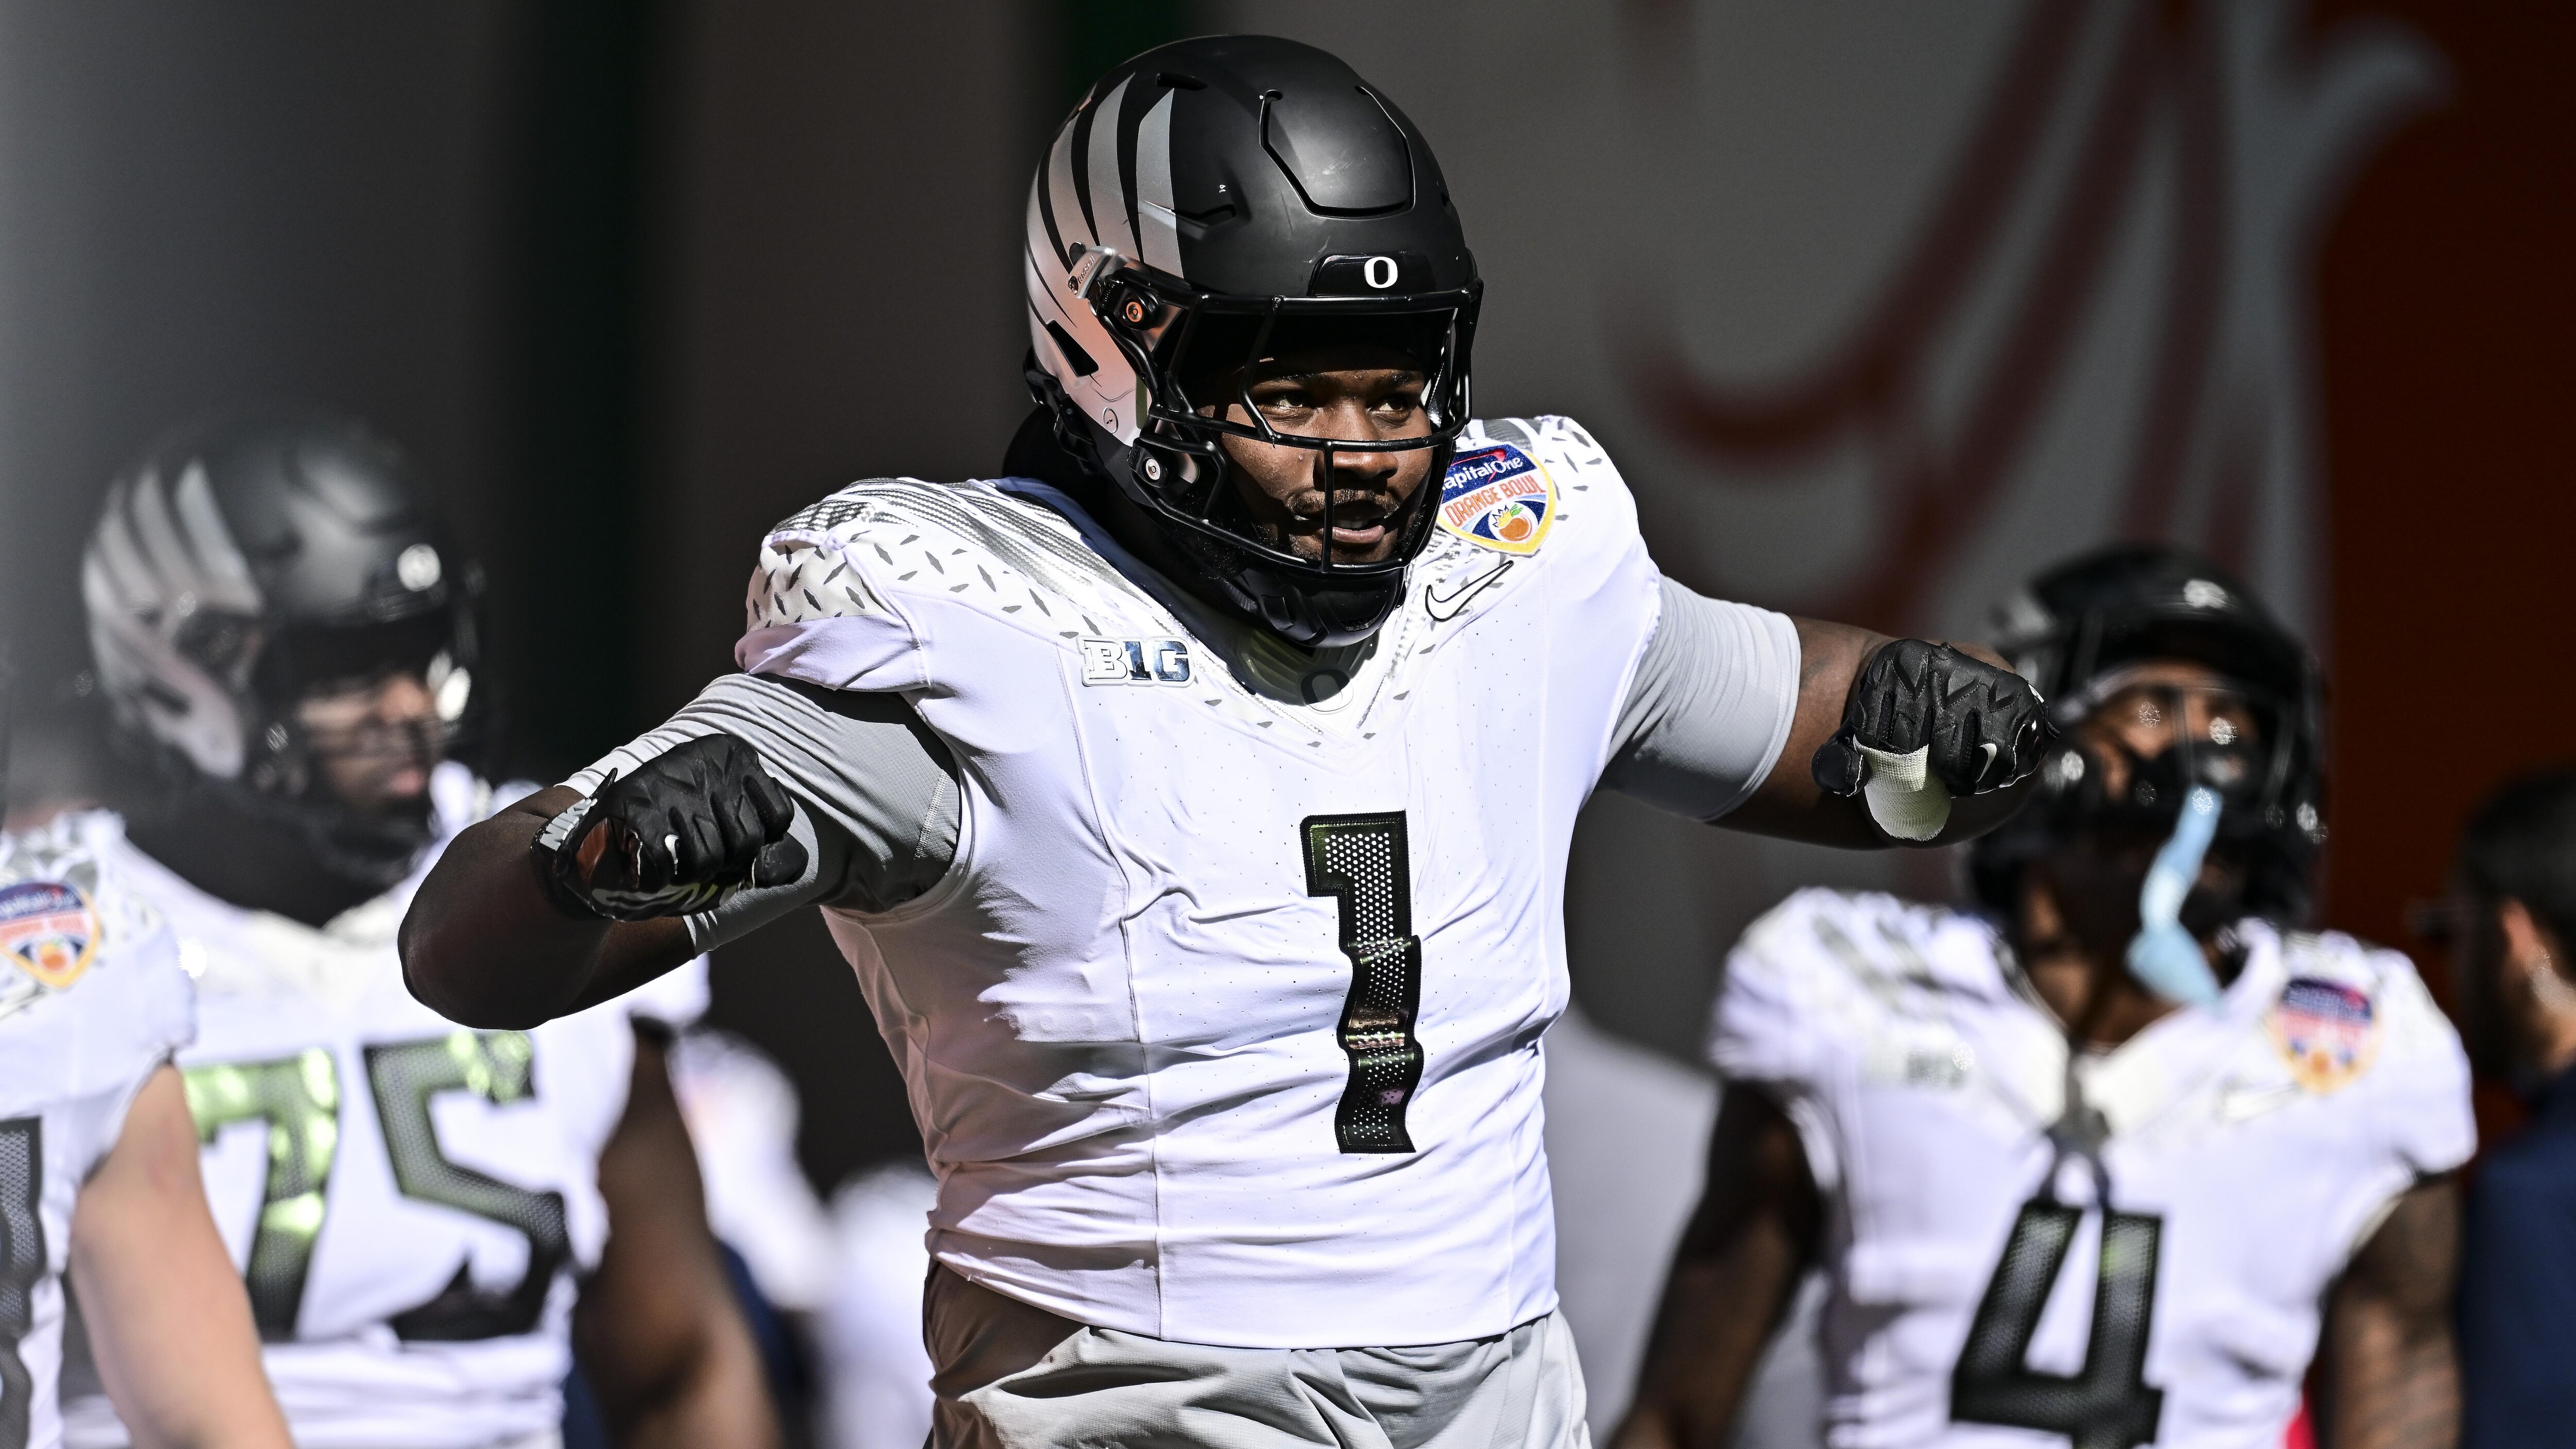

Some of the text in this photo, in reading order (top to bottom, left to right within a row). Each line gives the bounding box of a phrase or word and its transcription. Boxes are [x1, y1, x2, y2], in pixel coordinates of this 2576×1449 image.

[1364, 256, 1398, 288] O
[1442, 457, 1523, 490] apitalOne
[1445, 474, 1546, 527] ORANGE BOWL
[1299, 808, 1424, 1154] 1
[181, 1028, 571, 1346] 75
[1949, 1198, 2166, 1449] 4
